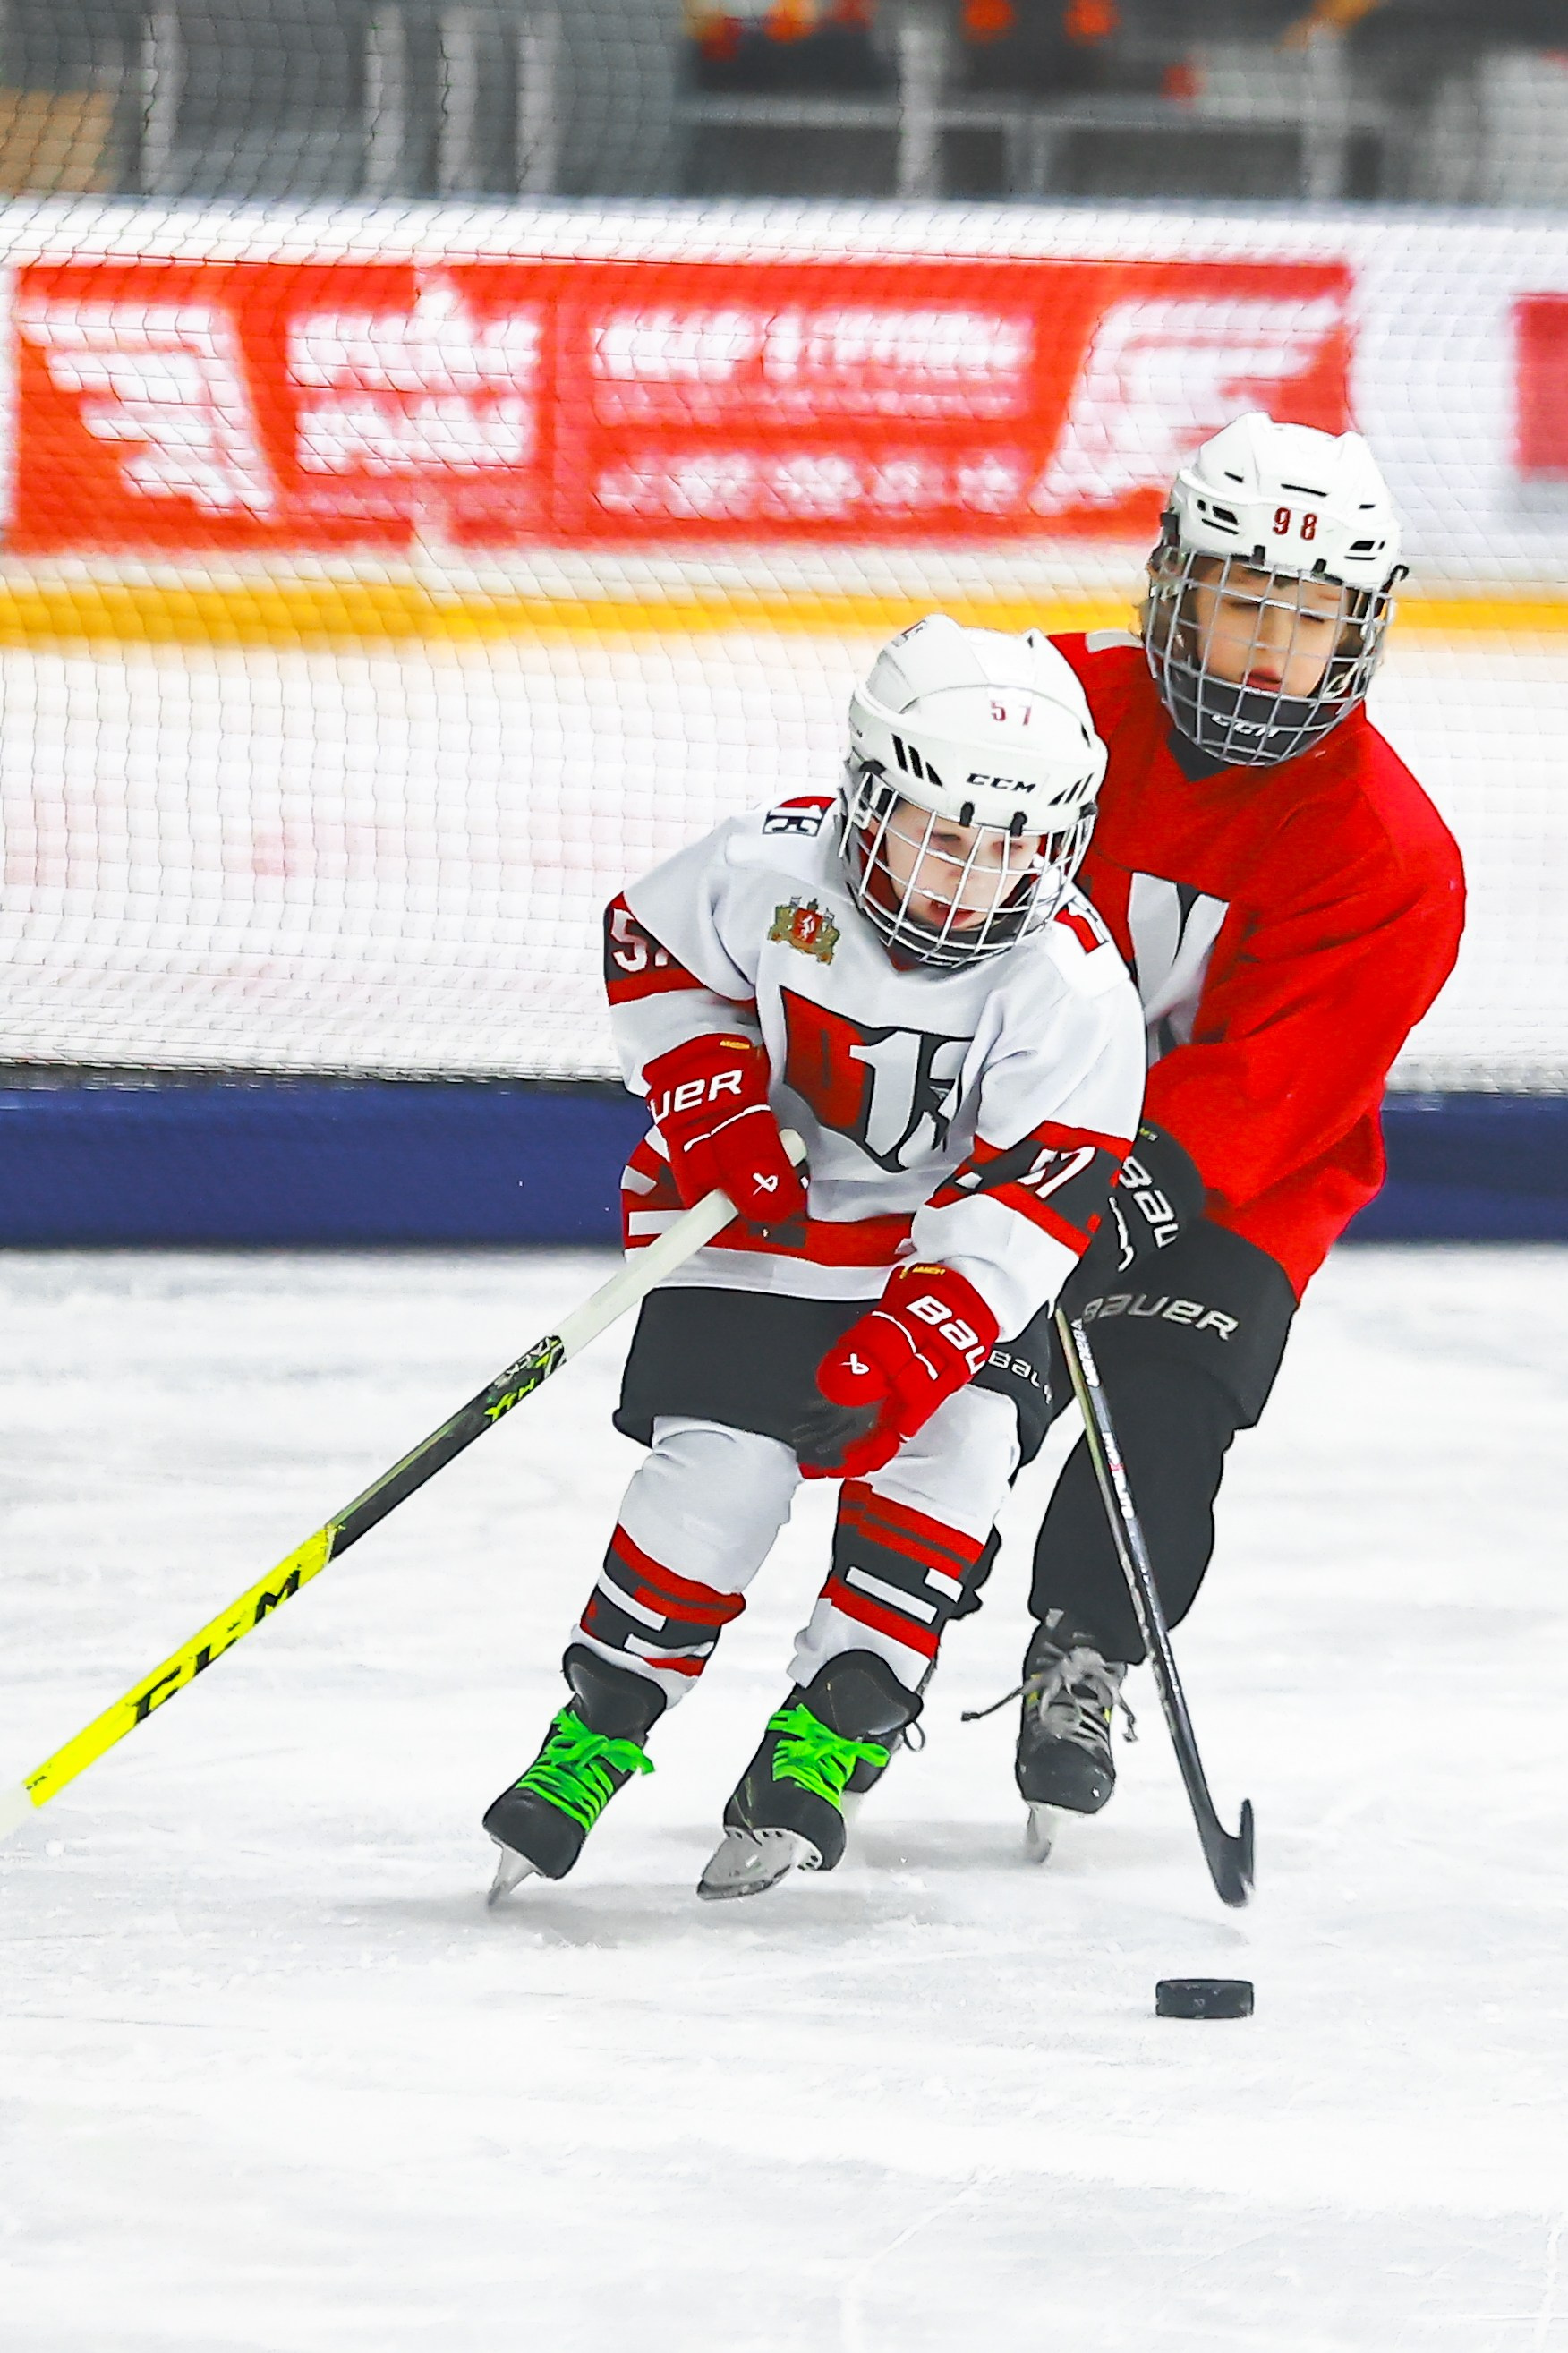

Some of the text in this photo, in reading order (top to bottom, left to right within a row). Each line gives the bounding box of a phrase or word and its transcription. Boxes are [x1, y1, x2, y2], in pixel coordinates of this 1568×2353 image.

[1273, 507, 1318, 541] 98
[991, 699, 1033, 727] 57
[966, 772, 1038, 795] CCM
[611, 907, 670, 973] 5
